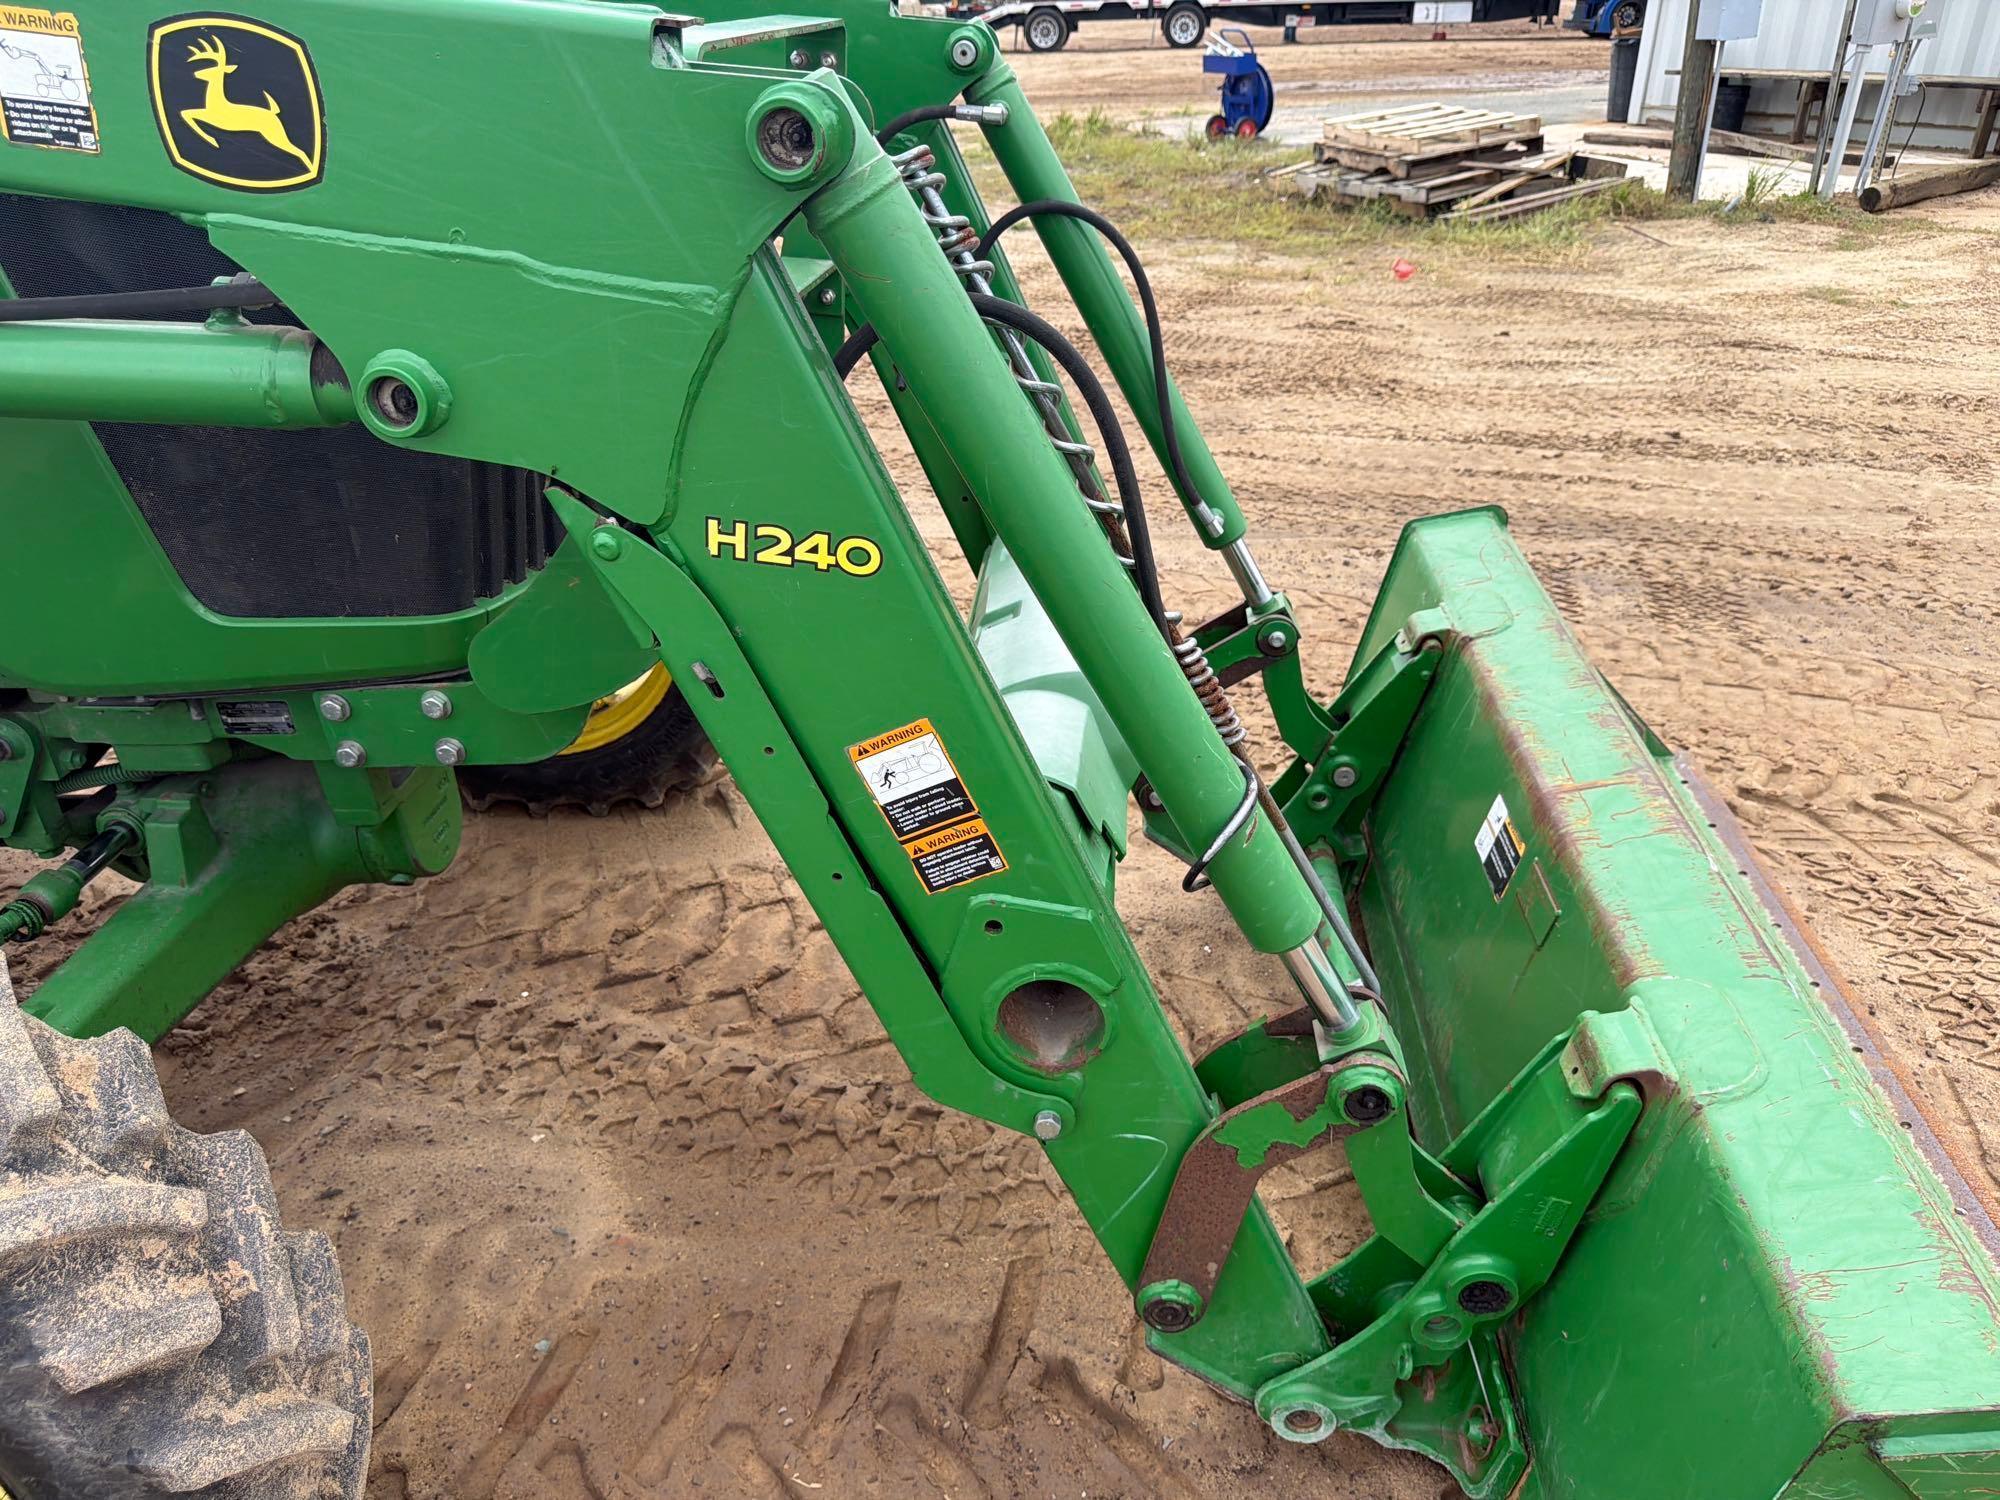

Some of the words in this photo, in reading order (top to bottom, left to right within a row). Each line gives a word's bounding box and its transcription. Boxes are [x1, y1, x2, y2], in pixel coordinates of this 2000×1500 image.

[4, 12, 74, 32] WARNING
[9, 110, 20, 118] Do
[49, 115, 65, 123] from
[34, 104, 53, 113] injury
[705, 516, 883, 577] H240
[869, 725, 923, 750] WARNING
[926, 826, 979, 849] WARNING
